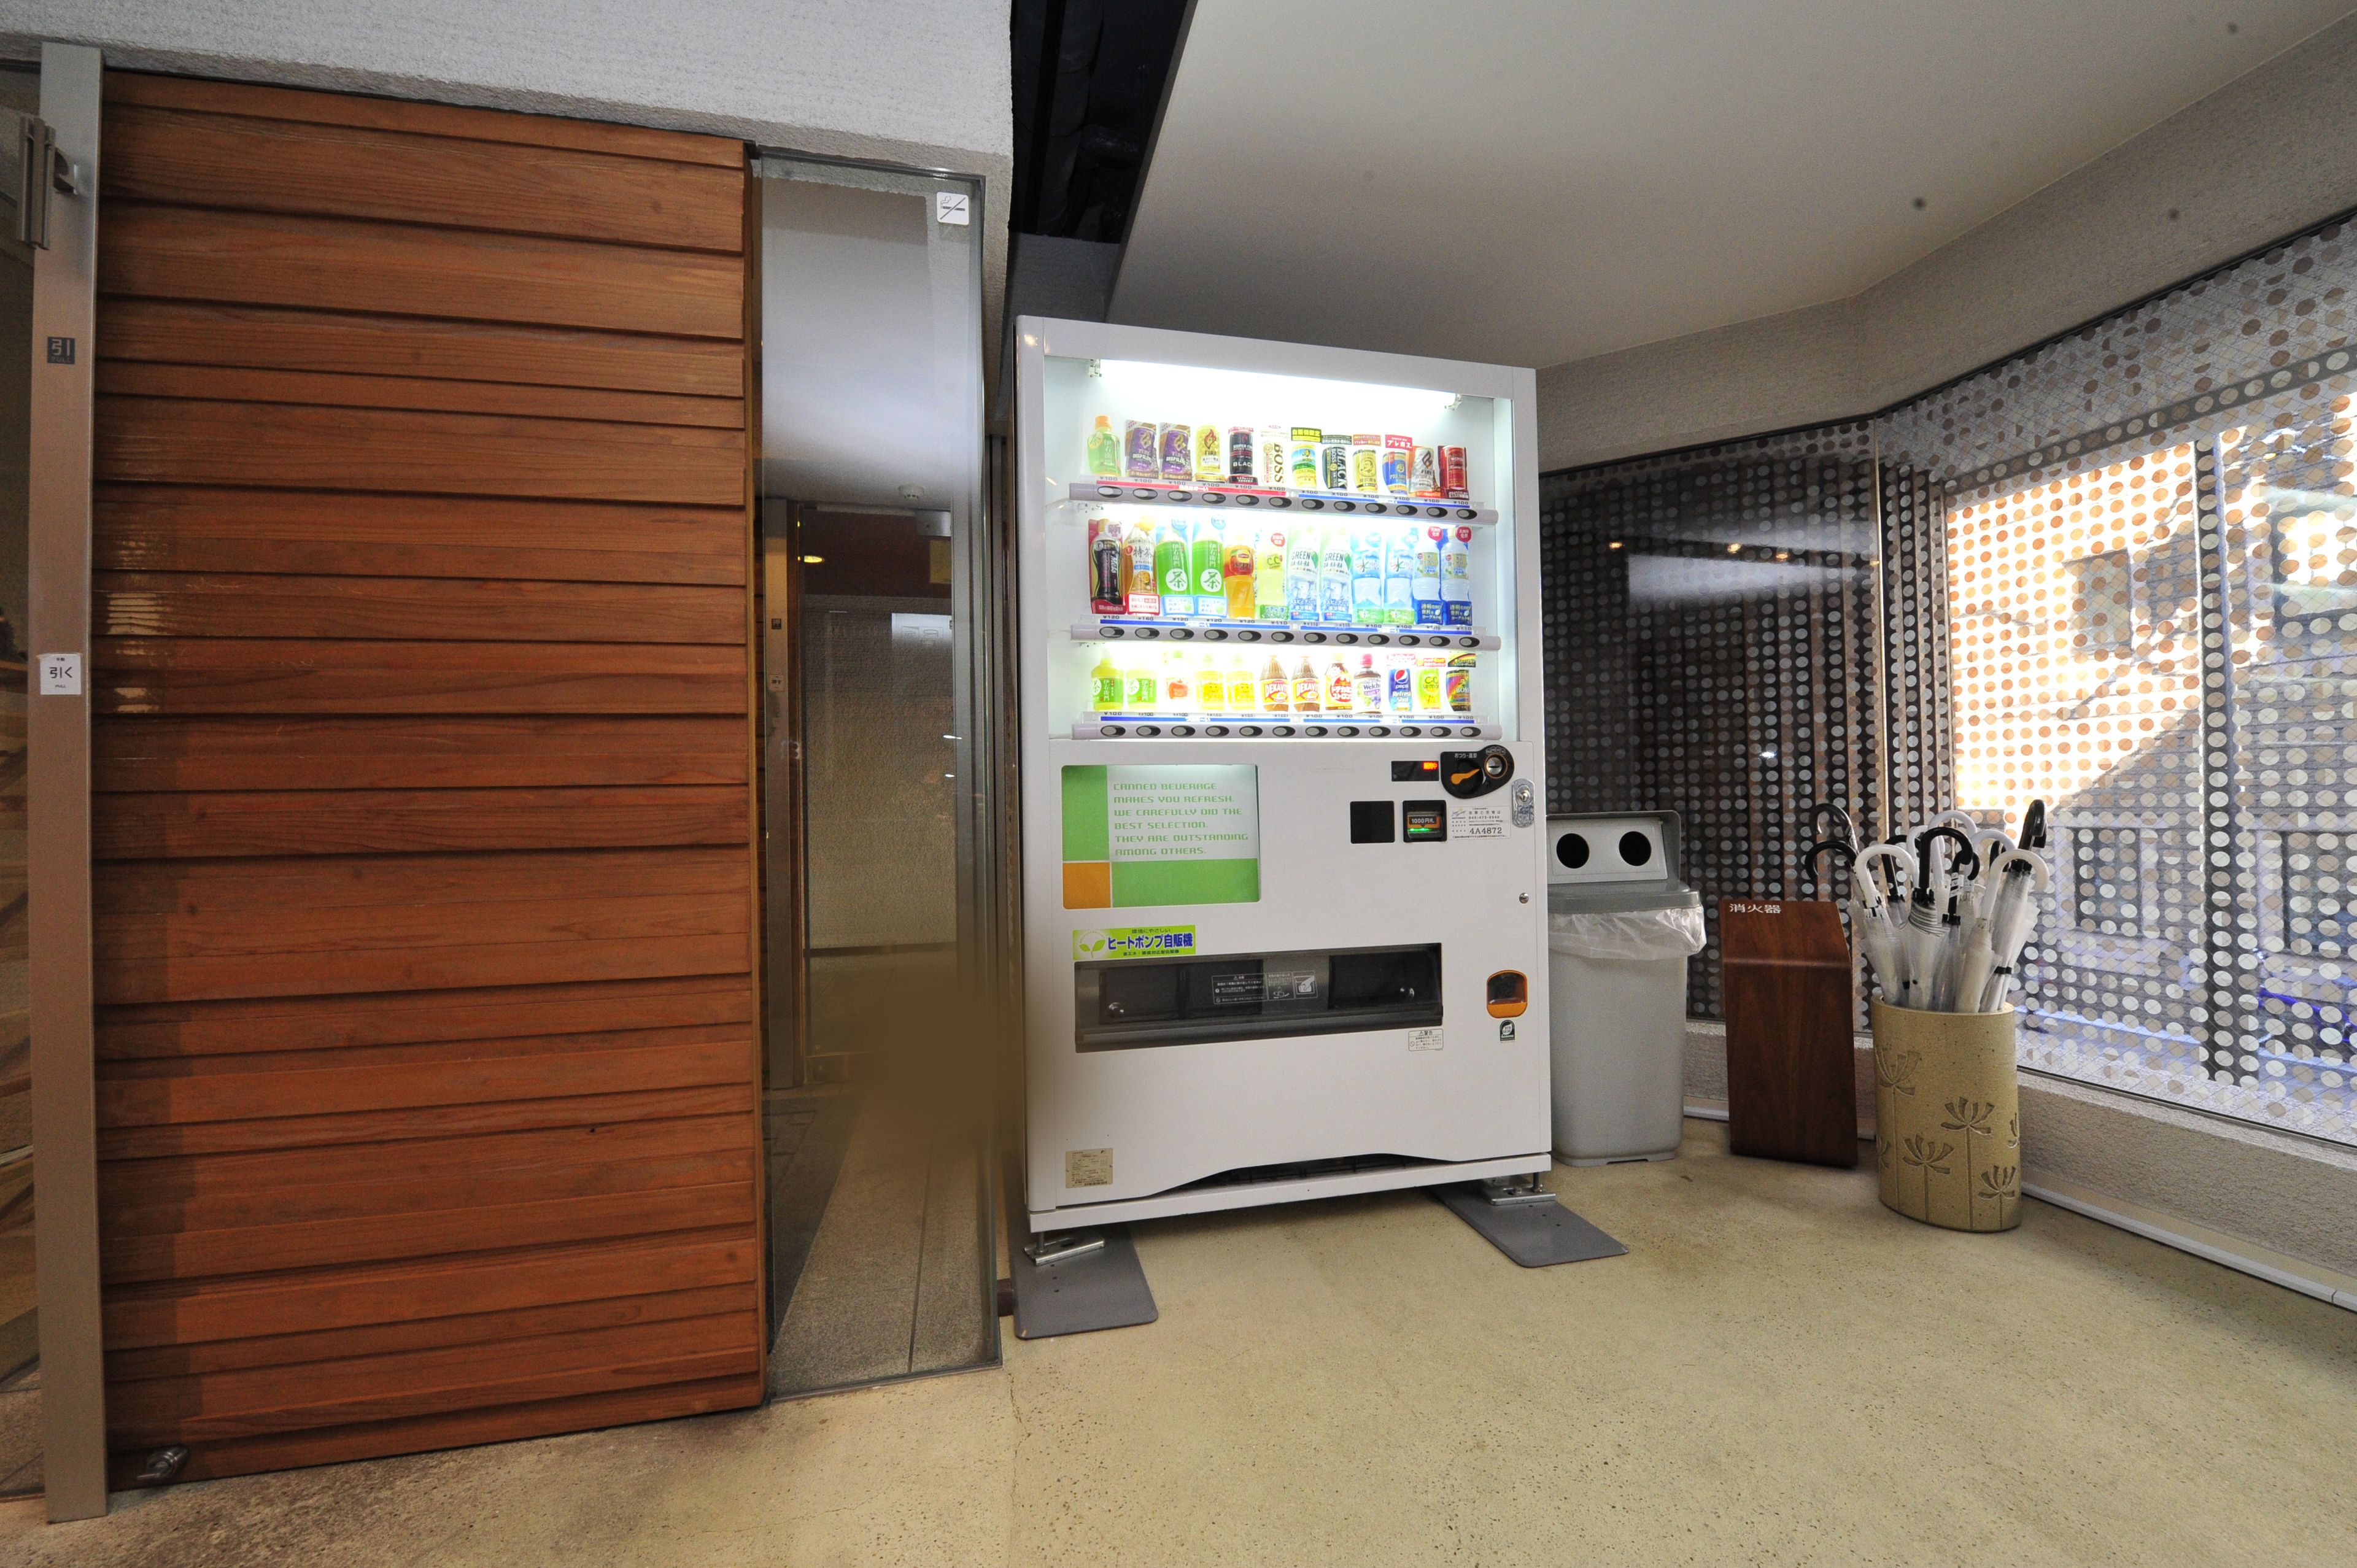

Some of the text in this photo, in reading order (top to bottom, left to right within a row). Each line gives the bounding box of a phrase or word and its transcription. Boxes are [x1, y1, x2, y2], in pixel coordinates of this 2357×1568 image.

[51, 339, 71, 356] 引
[1274, 442, 1284, 484] BOSS
[1337, 447, 1347, 489] BLACK
[1134, 546, 1153, 557] 特茶
[1291, 551, 1311, 560] GREEN
[1169, 571, 1186, 589] 茶
[1204, 571, 1220, 589] 茶
[49, 666, 72, 679] 引く
[1264, 682, 1288, 697] DEKAVIT
[1296, 683, 1318, 698] DEKAVIT
[1729, 903, 1781, 914] 消火器
[1108, 933, 1193, 950] ヒートポンプ自販機
